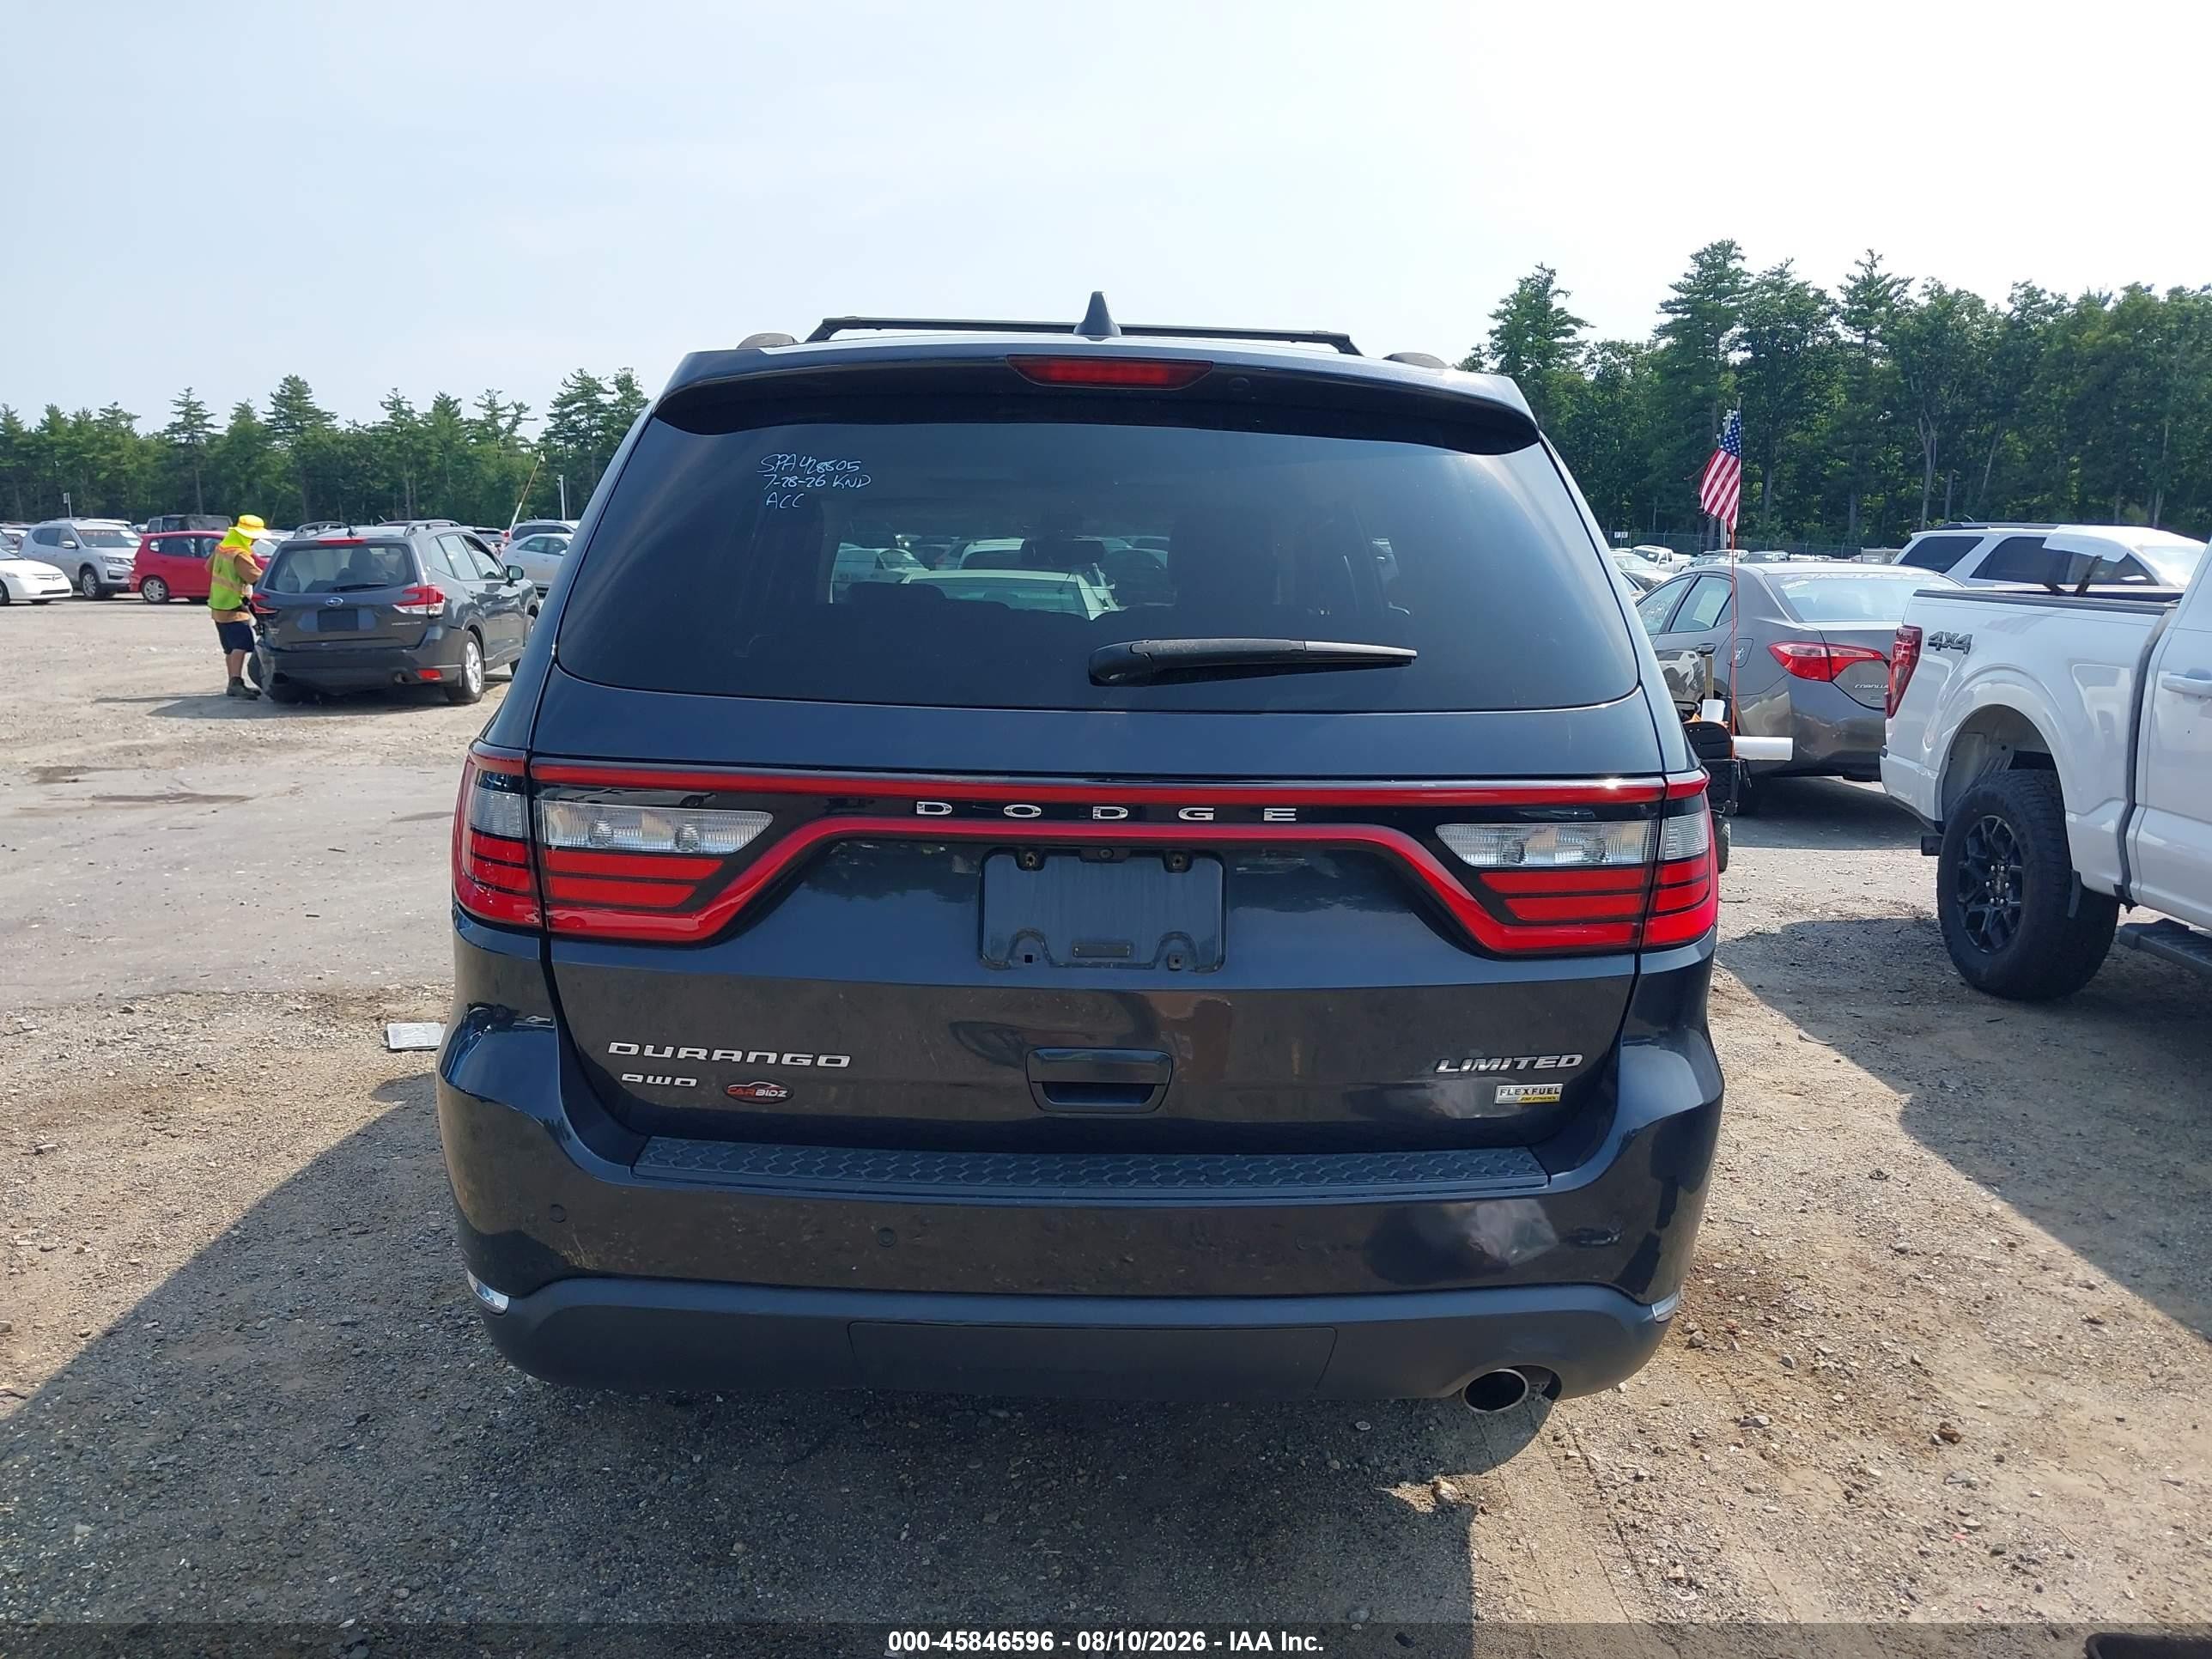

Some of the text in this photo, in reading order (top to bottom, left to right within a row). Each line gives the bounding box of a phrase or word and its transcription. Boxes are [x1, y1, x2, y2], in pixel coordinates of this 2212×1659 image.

[763, 474, 826, 489] 7-28-26
[766, 491, 805, 508] ACC
[916, 801, 1297, 822] DODGE
[607, 1042, 851, 1068] DURANGO
[1436, 1054, 1584, 1073] LIMITED
[621, 1073, 697, 1088] AWD
